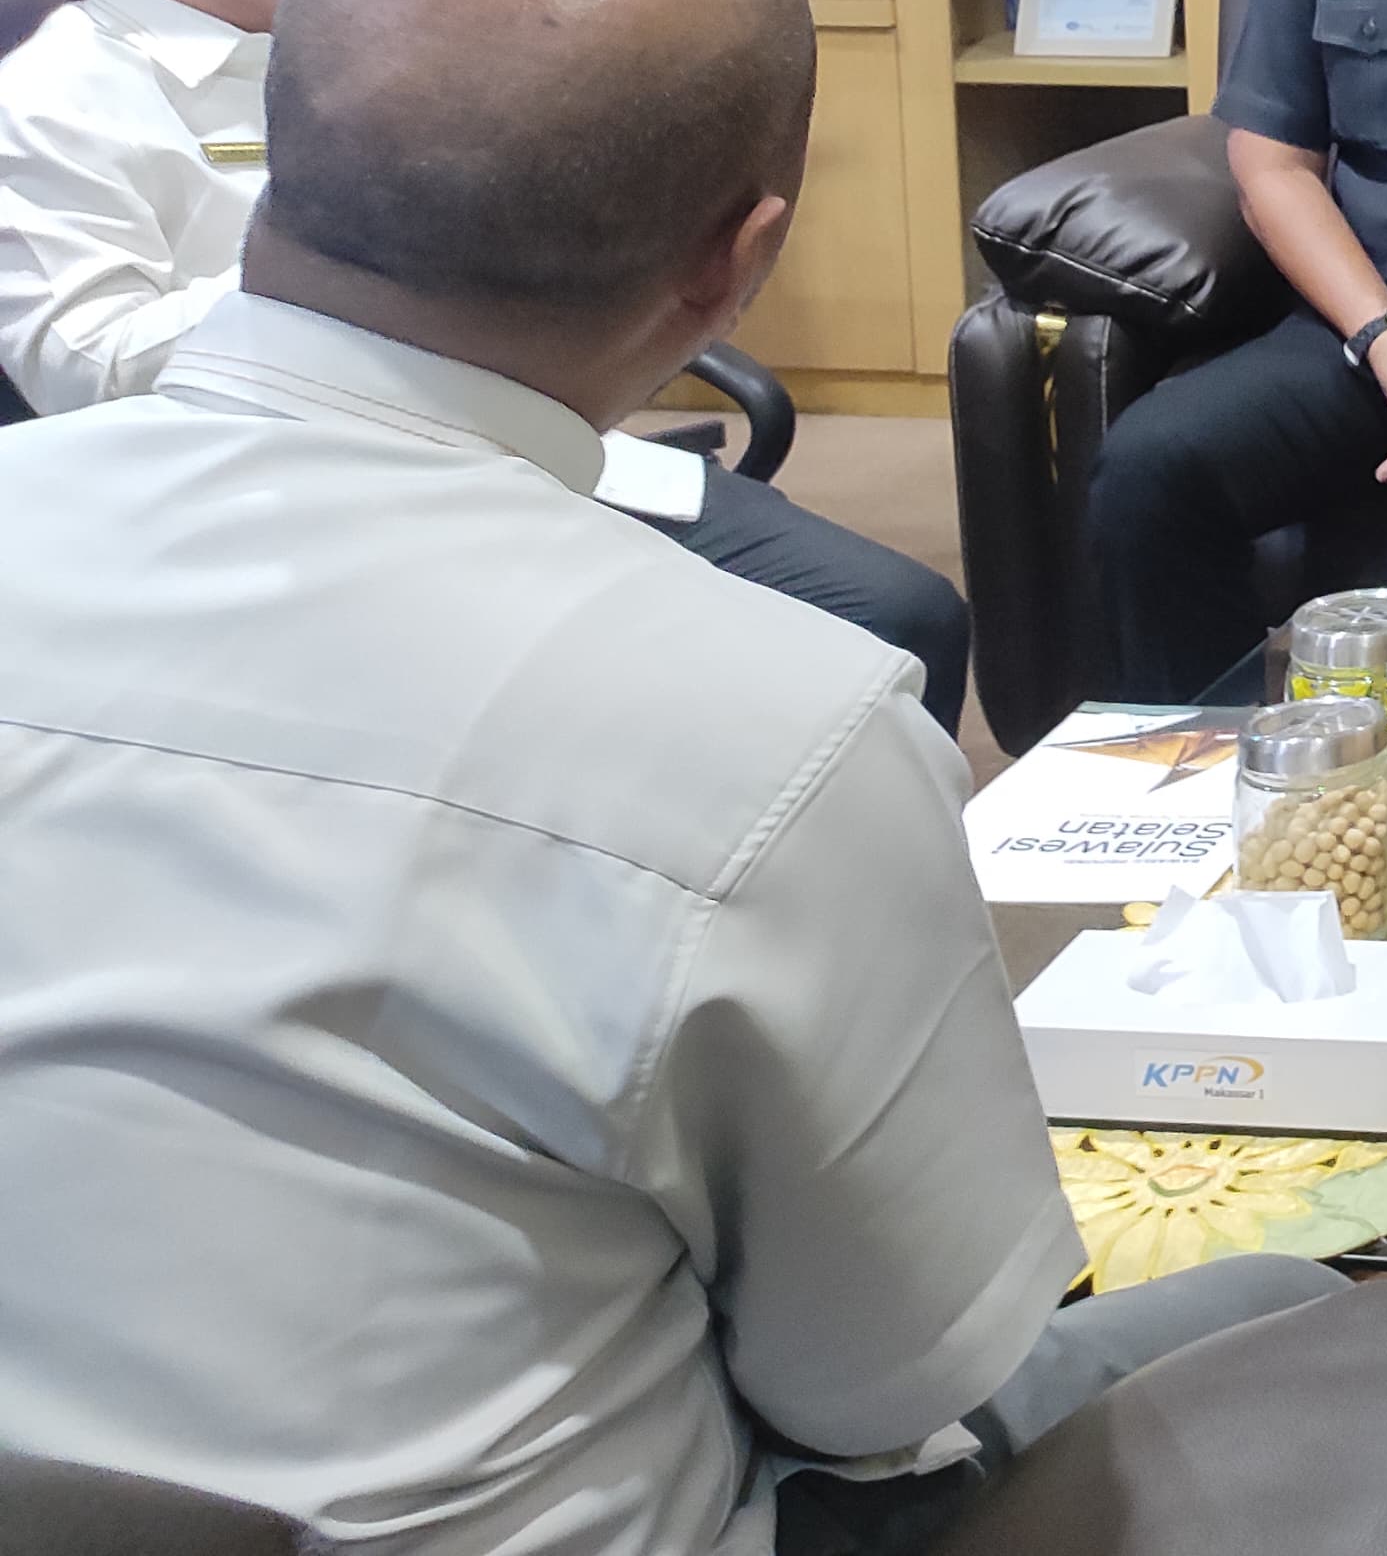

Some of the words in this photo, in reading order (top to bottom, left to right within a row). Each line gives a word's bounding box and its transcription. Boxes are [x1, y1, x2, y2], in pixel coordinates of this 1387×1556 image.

[1058, 819, 1233, 840] Selatan
[992, 837, 1217, 858] Sulawesi
[1142, 1062, 1240, 1088] KPPN
[1203, 1087, 1256, 1100] Makassar
